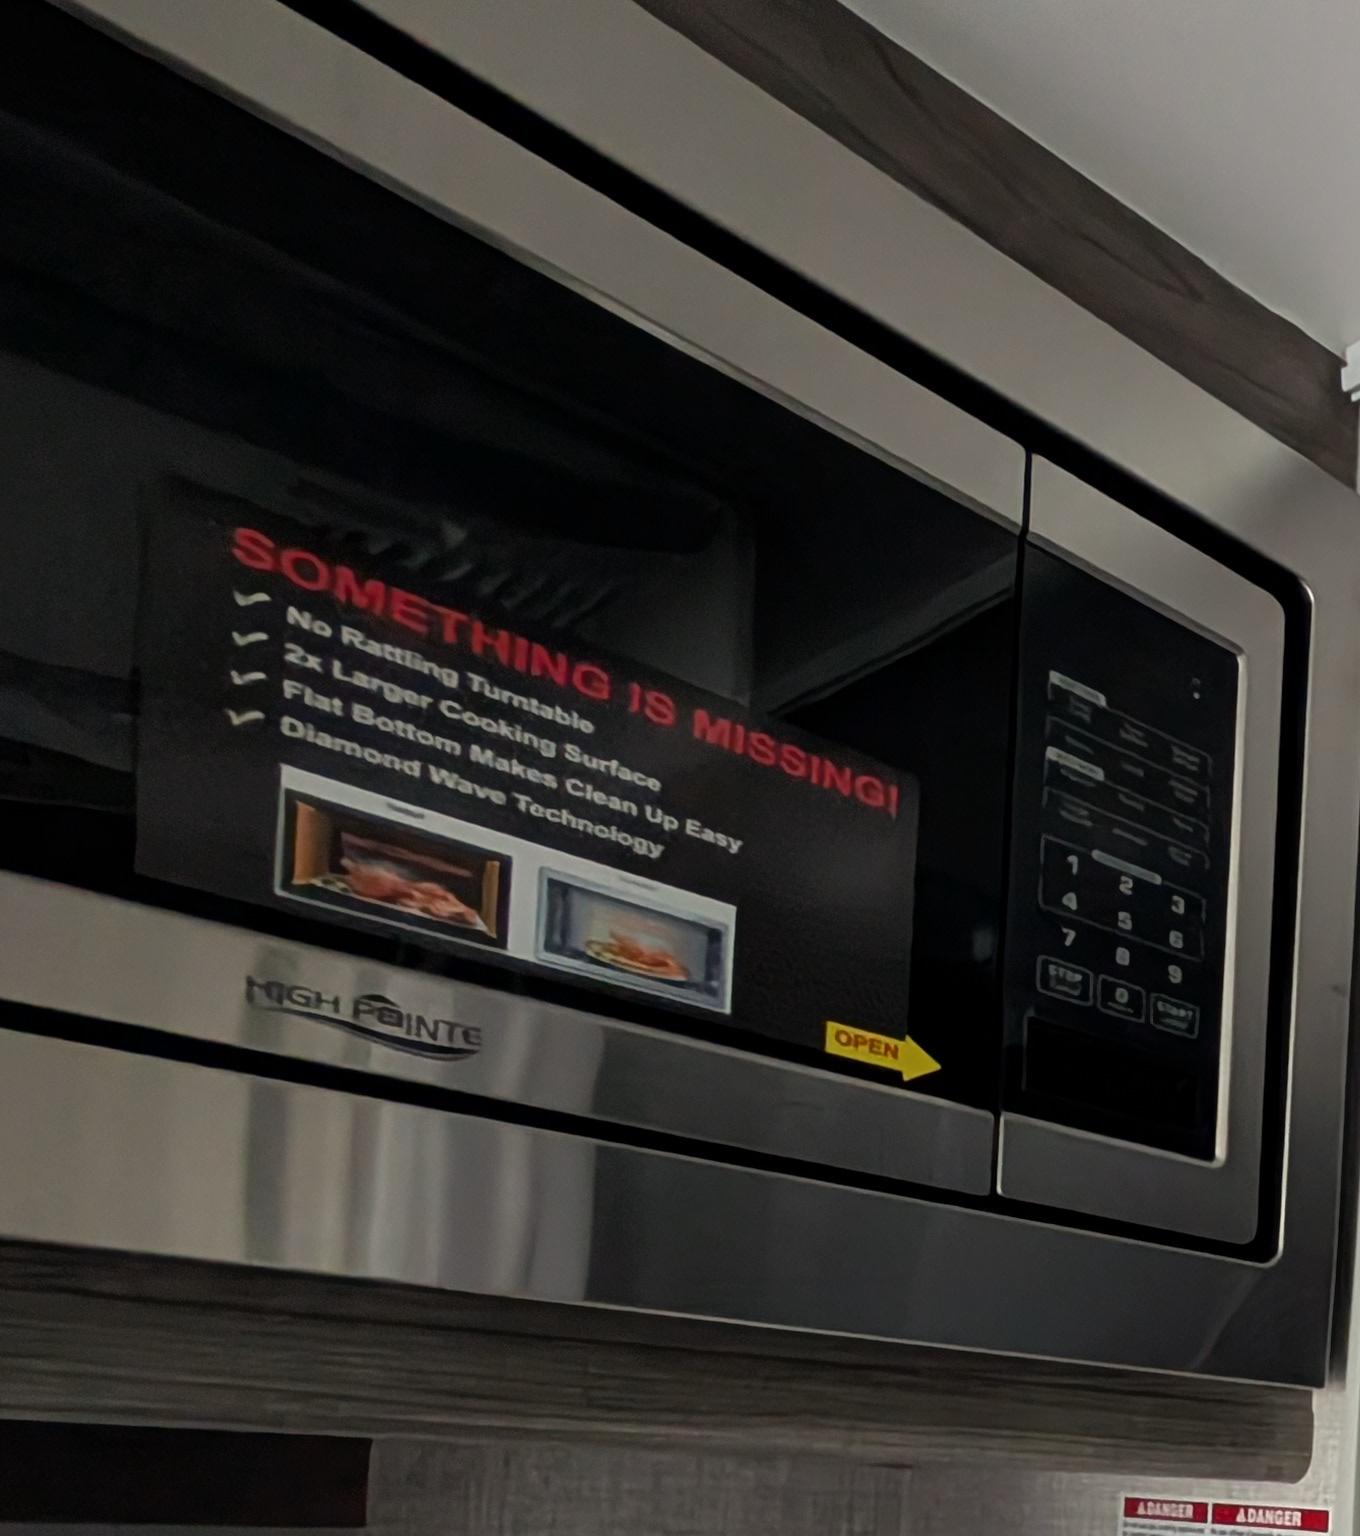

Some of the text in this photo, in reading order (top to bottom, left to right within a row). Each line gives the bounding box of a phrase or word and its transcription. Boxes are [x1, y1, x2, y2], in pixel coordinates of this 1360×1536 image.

[232, 527, 899, 820] SOMETHING IS MISSING!
[284, 643, 661, 792] 2x Larger Cooking Surface
[286, 606, 595, 734] No Rattling Turntable
[280, 716, 665, 858] Diamond Wave Technology
[283, 679, 743, 853] Flat Bottom Makes Clean Up Easy
[246, 976, 482, 1046] HIGH POINTE
[835, 1029, 899, 1060] OPEN
[1146, 1501, 1194, 1518] DANGER
[1246, 1509, 1302, 1527] DANGER
